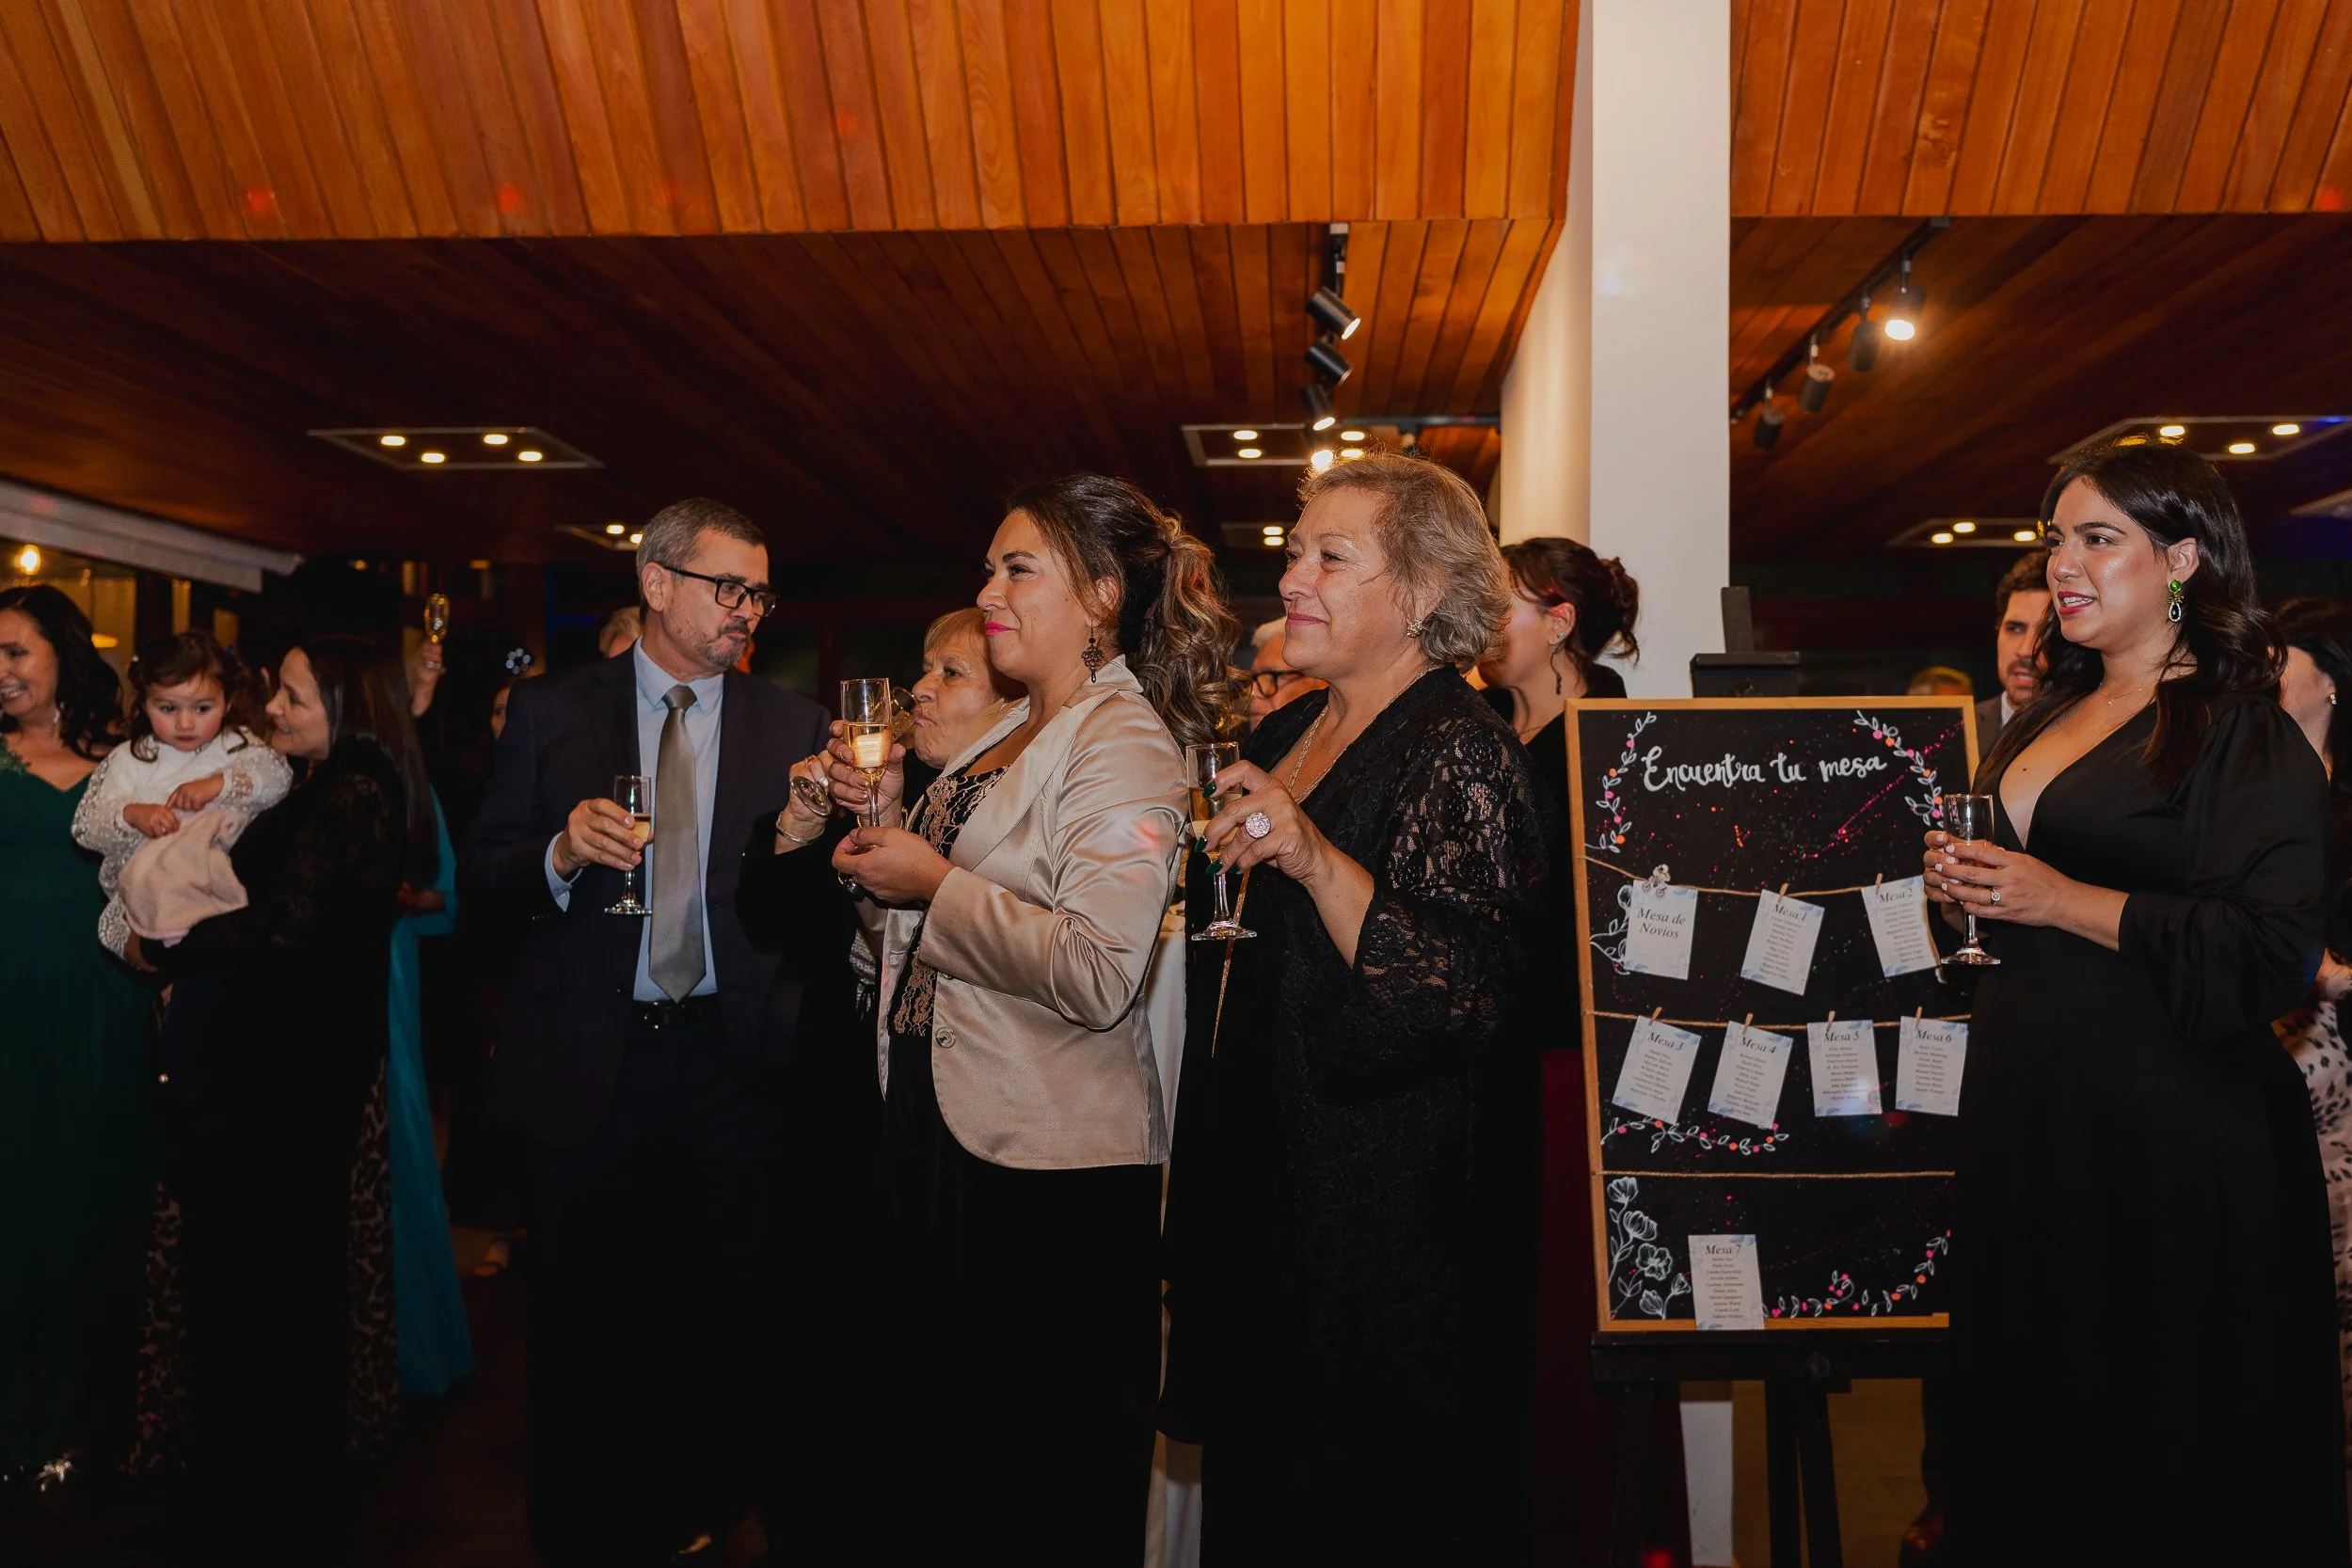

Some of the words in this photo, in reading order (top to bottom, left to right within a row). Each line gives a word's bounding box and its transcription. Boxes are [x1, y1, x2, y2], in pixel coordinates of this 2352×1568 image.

[1641, 745, 1766, 792] Encuentra
[1770, 752, 1806, 783] tu
[1820, 755, 1887, 783] mesa
[1880, 892, 1905, 903] Mesa
[1907, 887, 1913, 897] 2
[1637, 908, 1669, 923] Mesa
[1671, 913, 1686, 925] de
[1772, 904, 1799, 919] Mesa
[1802, 912, 1807, 921] 1
[1639, 922, 1679, 938] Novios
[1647, 1032, 1674, 1048] Mesa
[1676, 1041, 1684, 1051] 3
[1823, 1031, 1851, 1042] Mesa
[1853, 1031, 1859, 1041] 5
[1915, 1030, 1943, 1041] Mesa
[1945, 1034, 1952, 1042] 6
[1740, 1037, 1767, 1052] Mesa
[1769, 1045, 1776, 1053] 4
[1705, 1244, 1732, 1255] Mesa
[1736, 1244, 1741, 1254] 7
